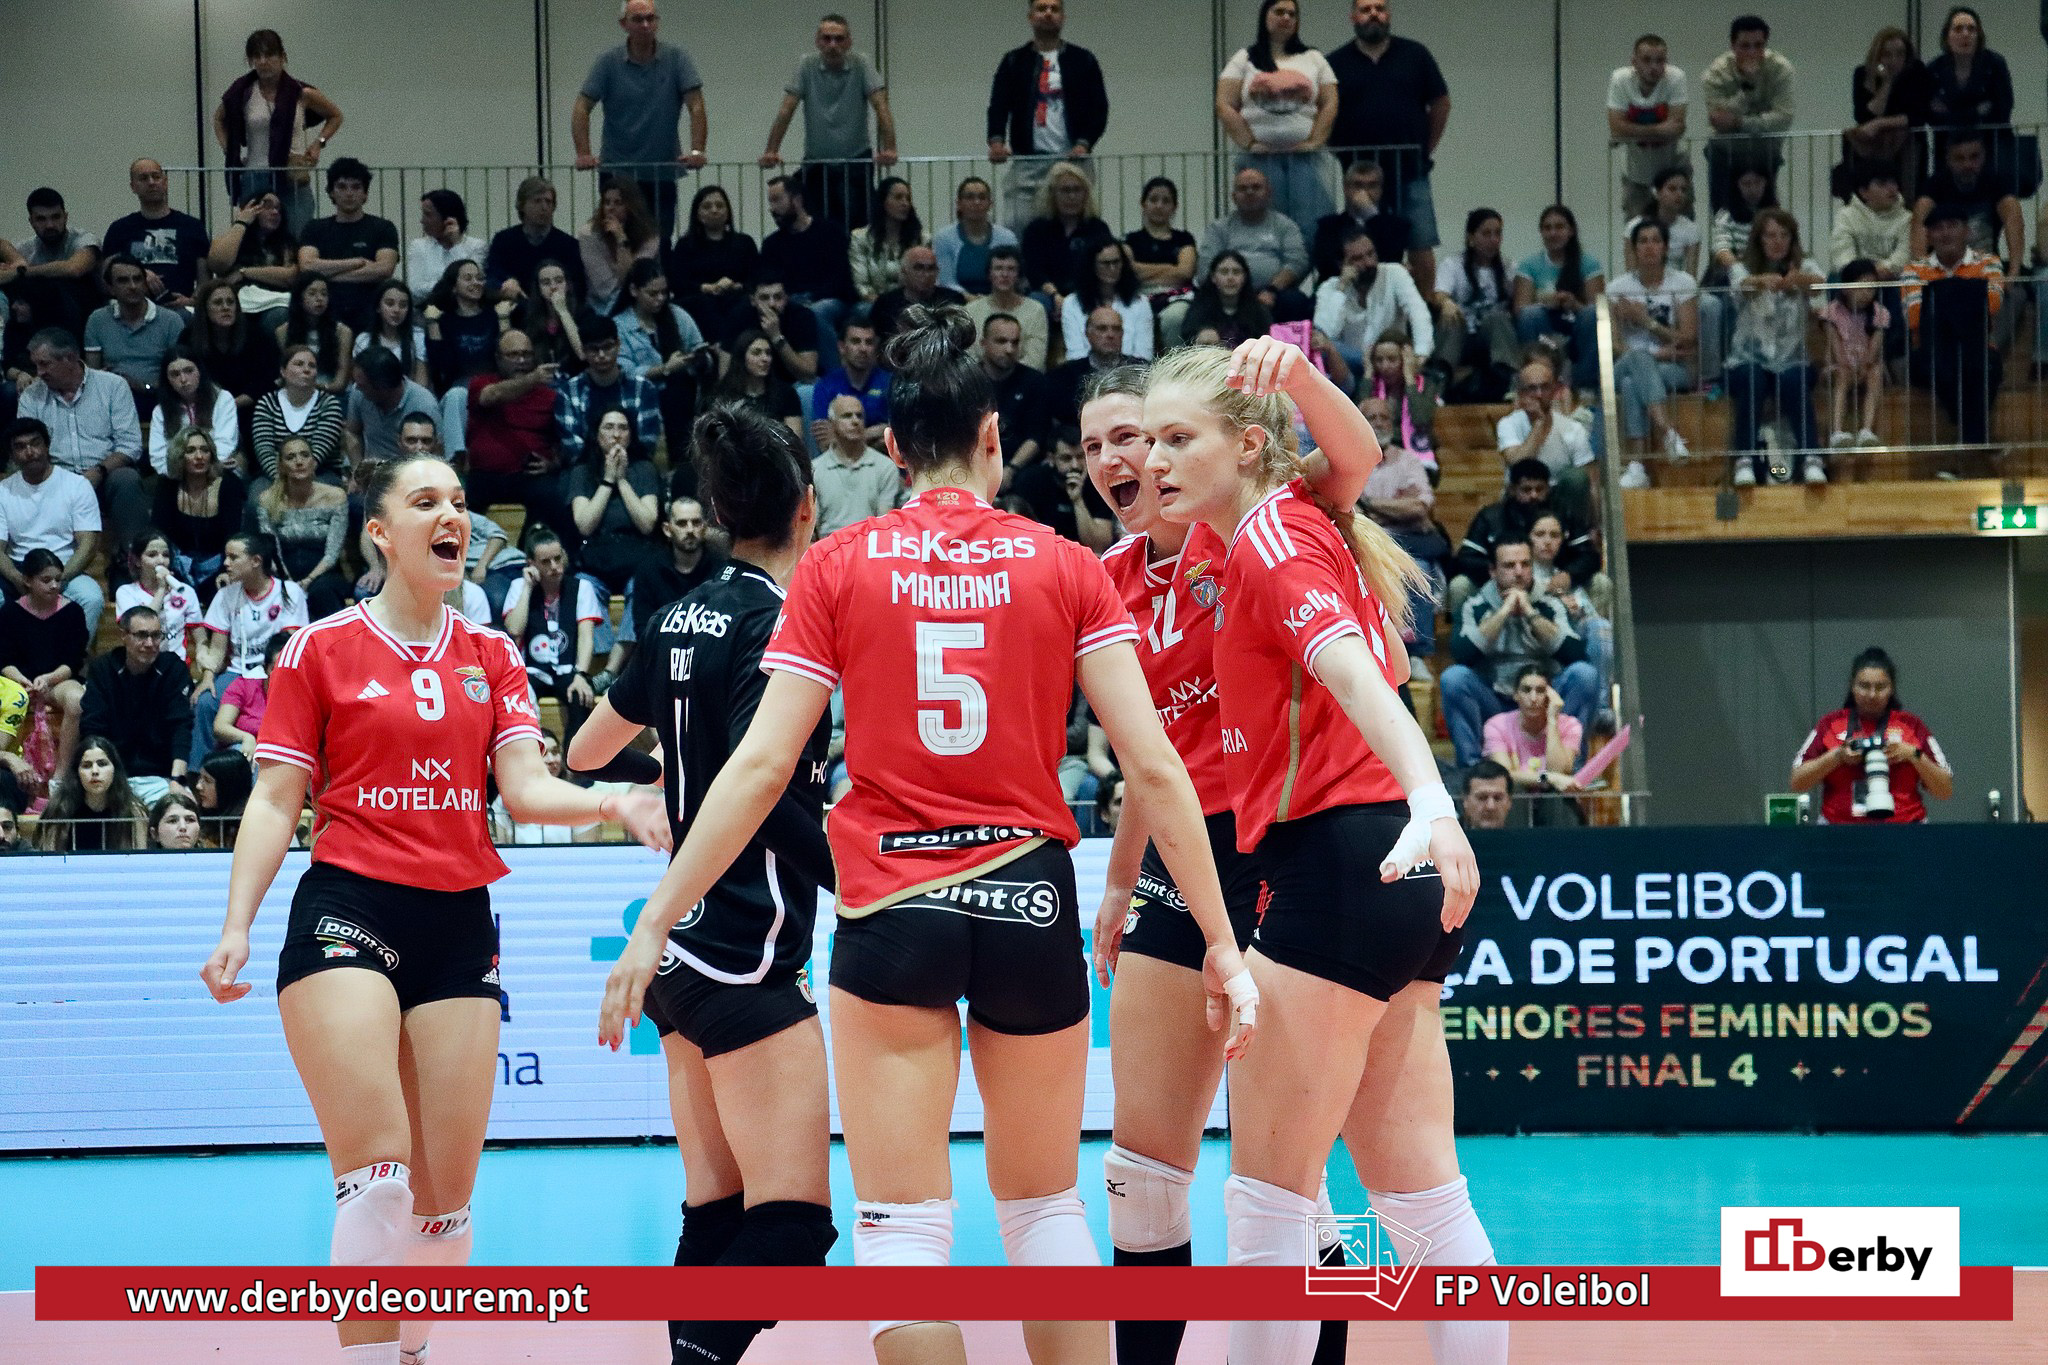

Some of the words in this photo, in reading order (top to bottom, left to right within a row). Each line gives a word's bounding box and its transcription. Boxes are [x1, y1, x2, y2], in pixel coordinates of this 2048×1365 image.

[867, 530, 1036, 564] LisKasas
[891, 570, 1011, 610] MARIANA
[1283, 589, 1342, 637] Kelly
[410, 668, 446, 721] 9
[916, 622, 988, 756] 5
[411, 757, 452, 782] NX
[357, 785, 482, 812] HOTELARI
[1501, 870, 1825, 922] VOLEIBOL
[1530, 937, 1615, 985] DE
[1635, 934, 1998, 985] PORTUGAL
[1659, 1002, 1933, 1039] FEMININOS
[1577, 1053, 1717, 1088] FINAL
[1728, 1052, 1759, 1087] 4
